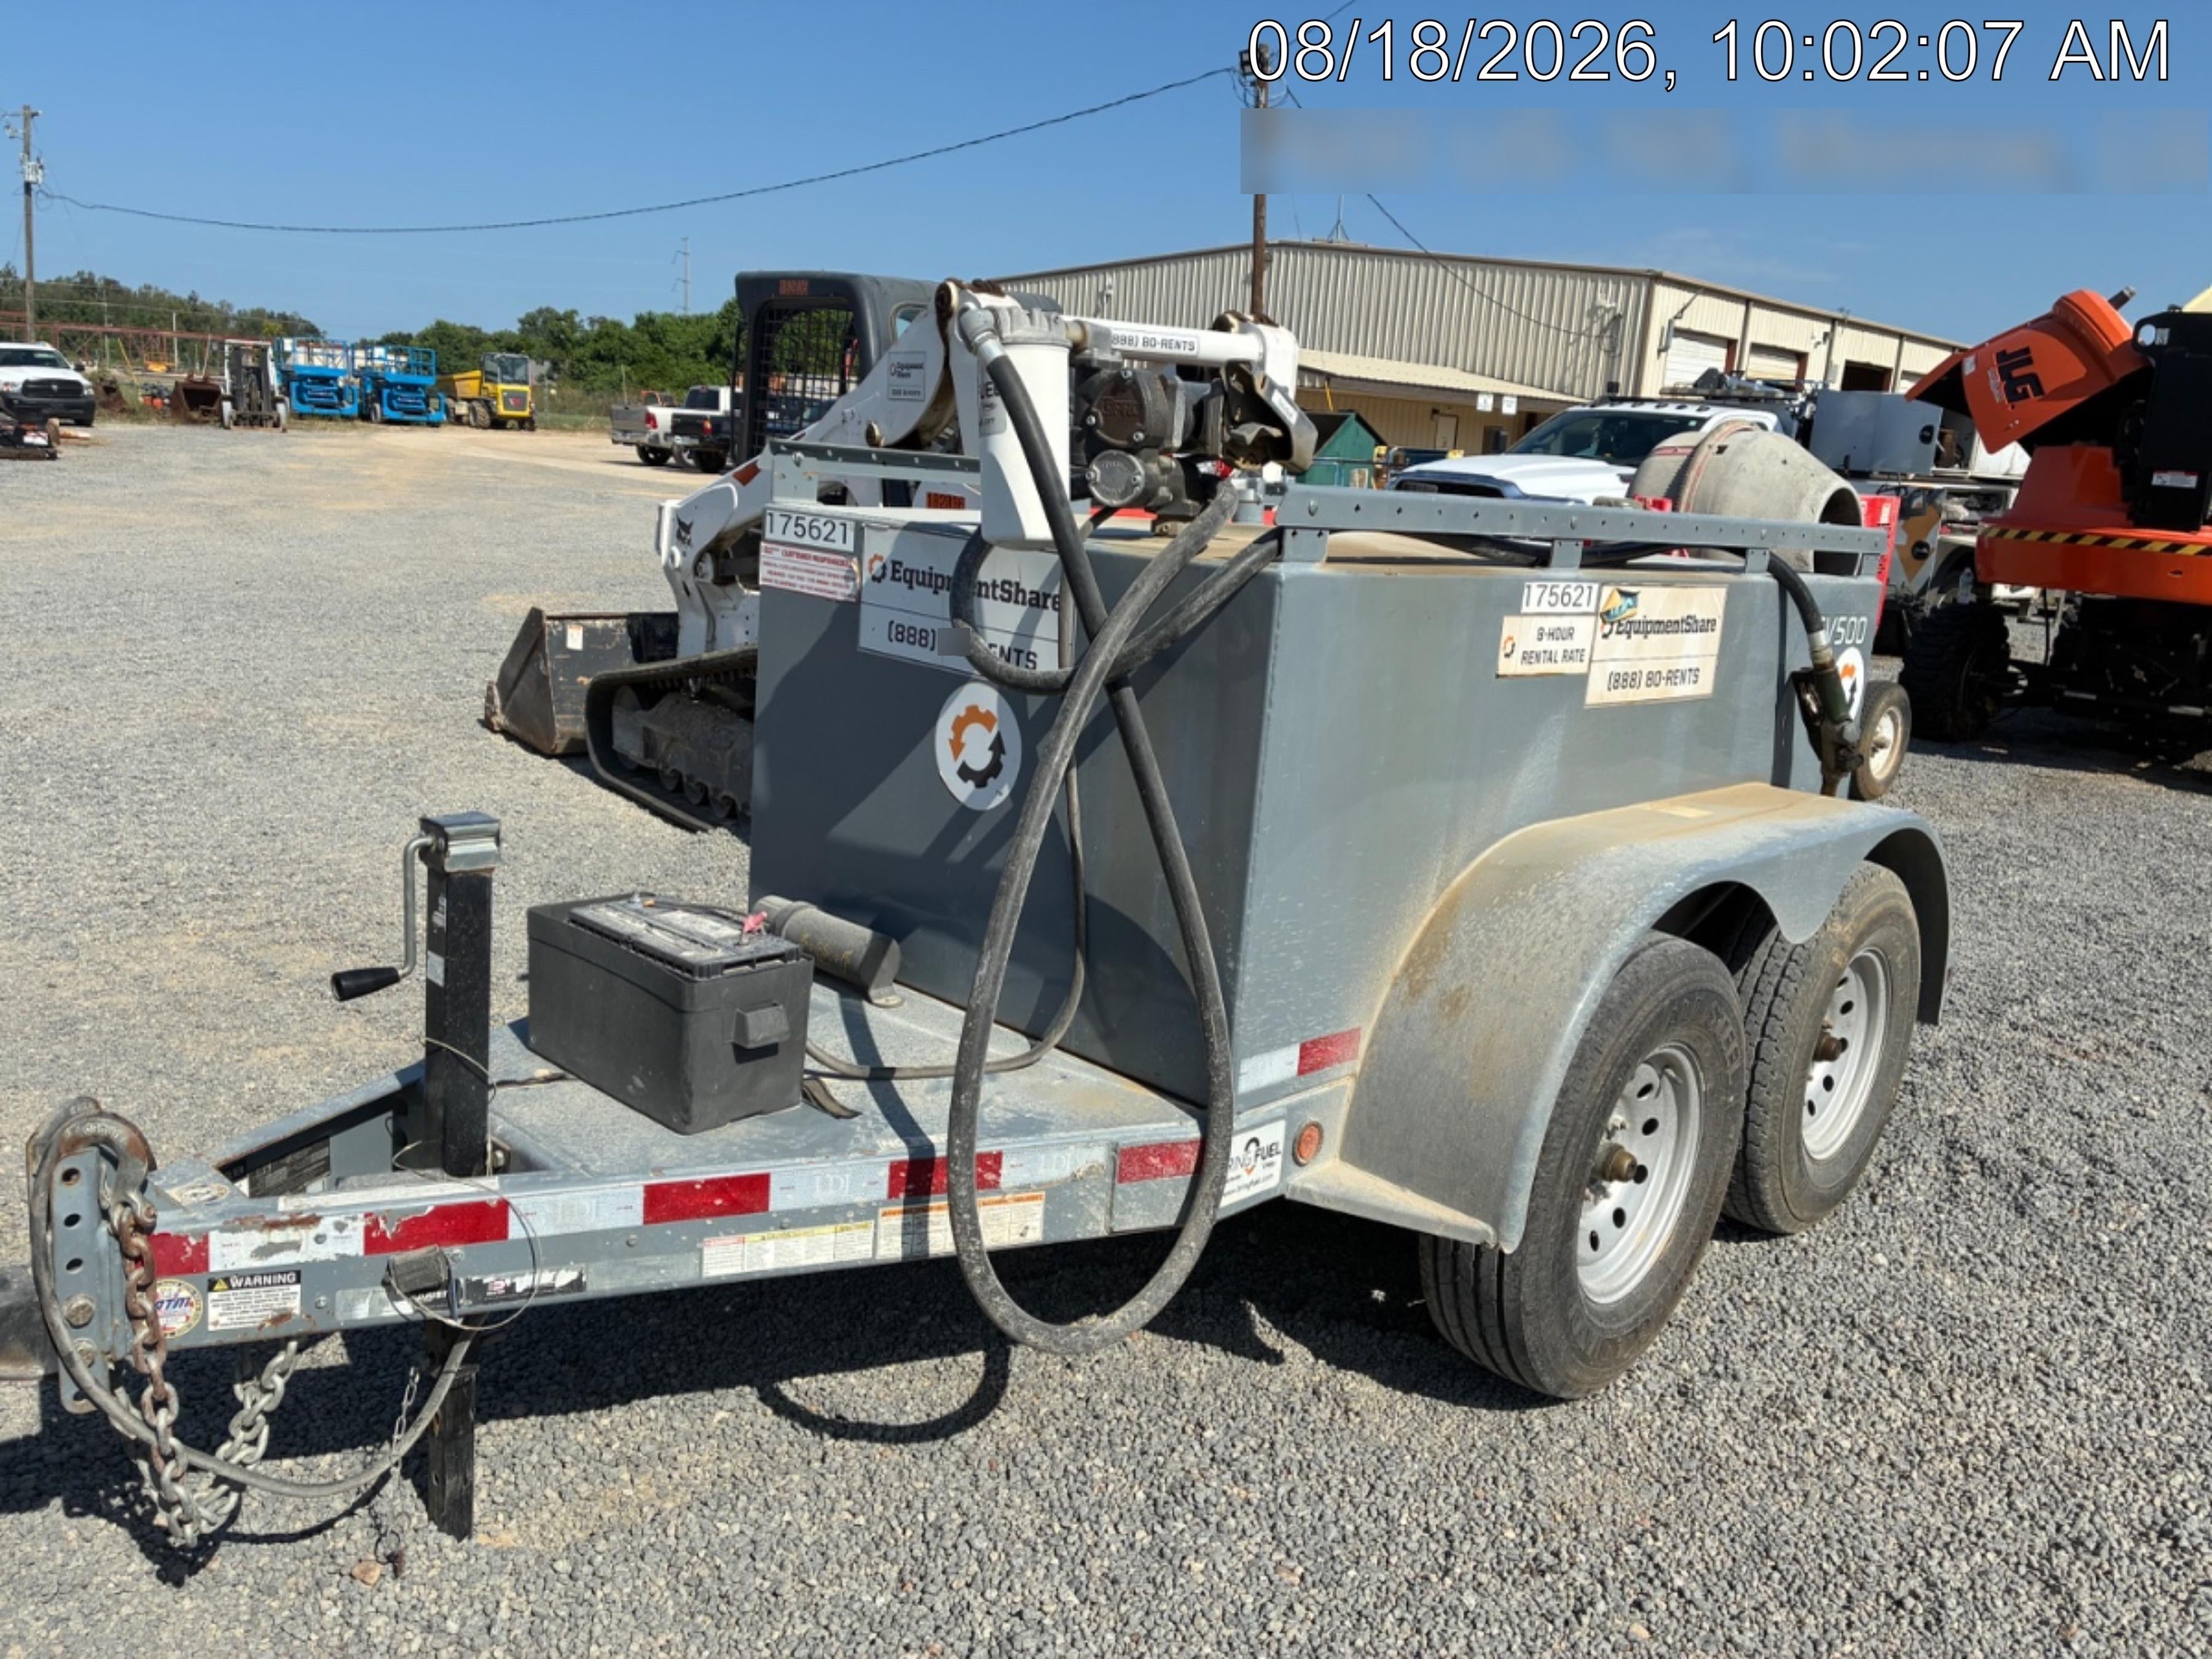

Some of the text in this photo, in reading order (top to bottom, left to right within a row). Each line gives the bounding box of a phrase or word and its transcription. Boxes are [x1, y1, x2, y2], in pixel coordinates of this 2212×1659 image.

[1996, 345, 2045, 403] JLG
[767, 512, 848, 545] 175621
[1524, 584, 1593, 607] 175621
[888, 620, 936, 651] (888)
[1615, 615, 1717, 640] EquipmentShare
[1521, 648, 1586, 665] RENTAL RATE
[230, 1272, 296, 1288] WARNING
